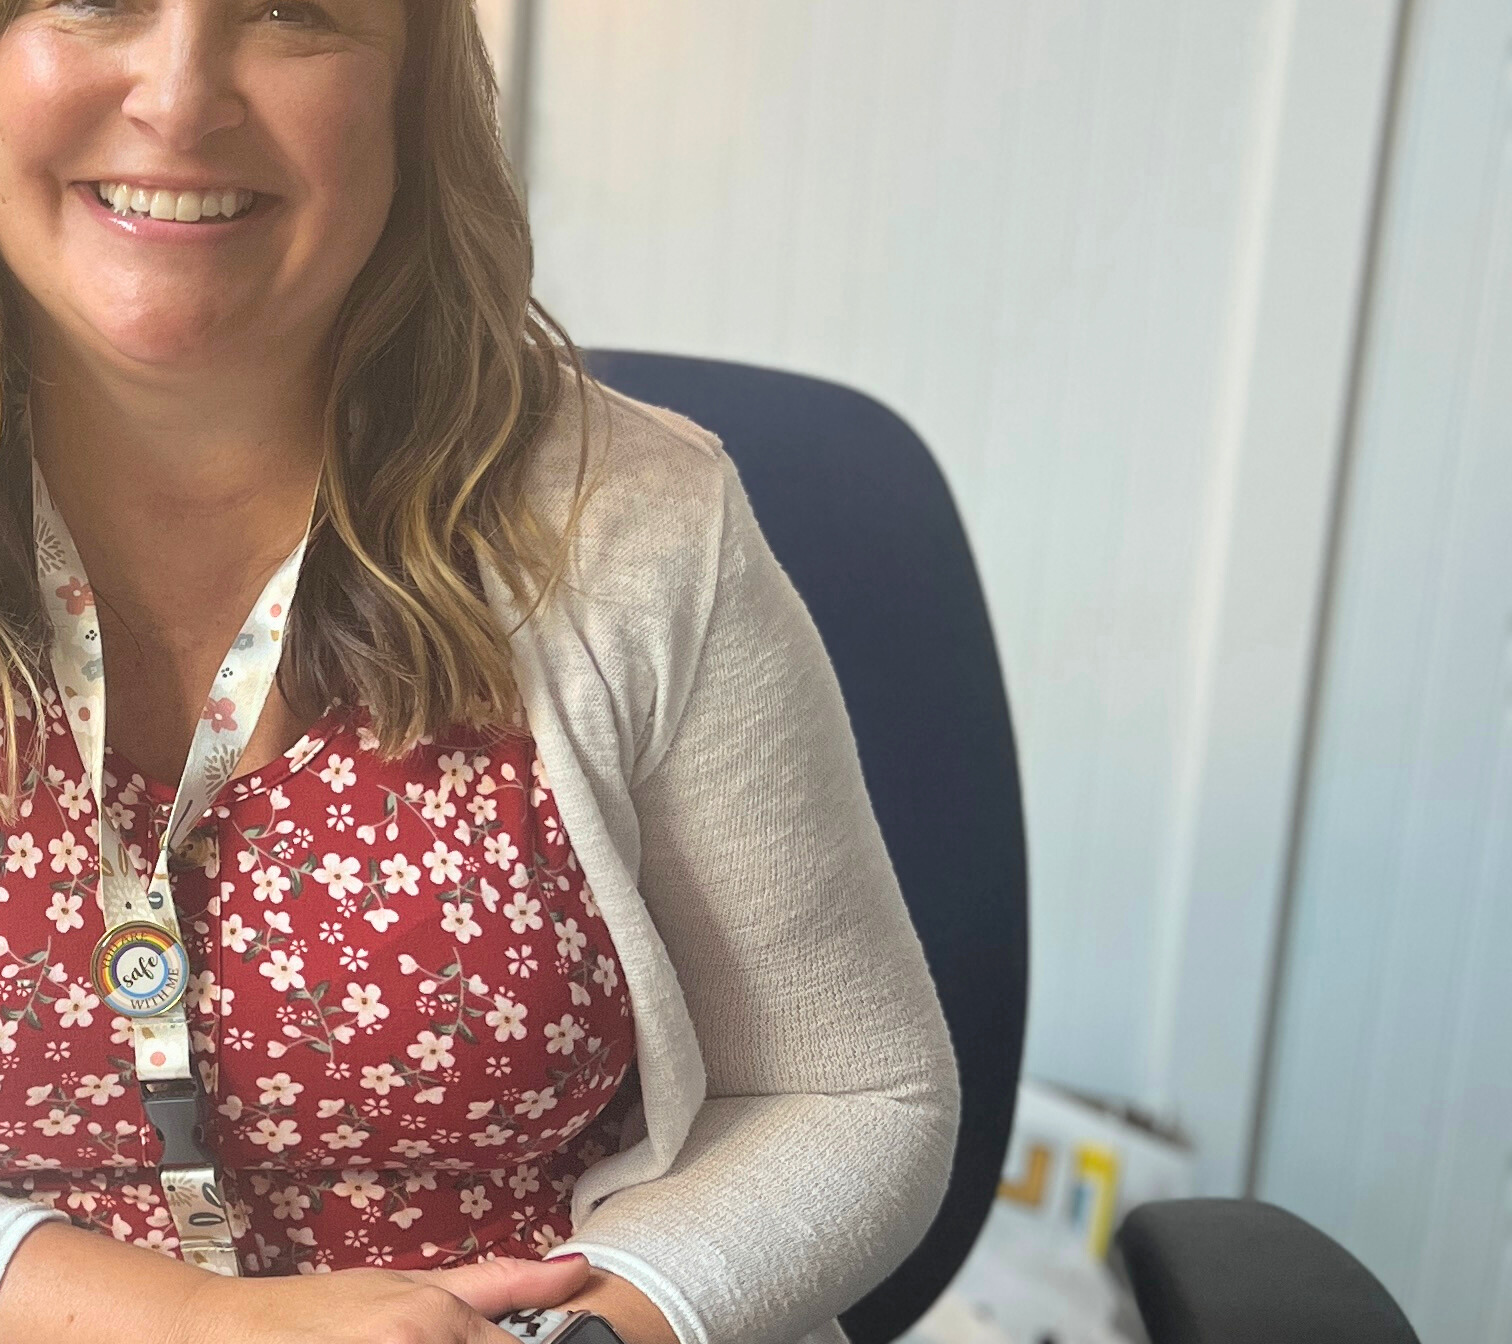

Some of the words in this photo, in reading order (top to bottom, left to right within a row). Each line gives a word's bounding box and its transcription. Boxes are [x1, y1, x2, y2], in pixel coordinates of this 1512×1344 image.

[102, 943, 118, 968] YOU
[122, 955, 159, 988] safe
[130, 990, 168, 1010] WITH
[166, 967, 179, 990] ME
